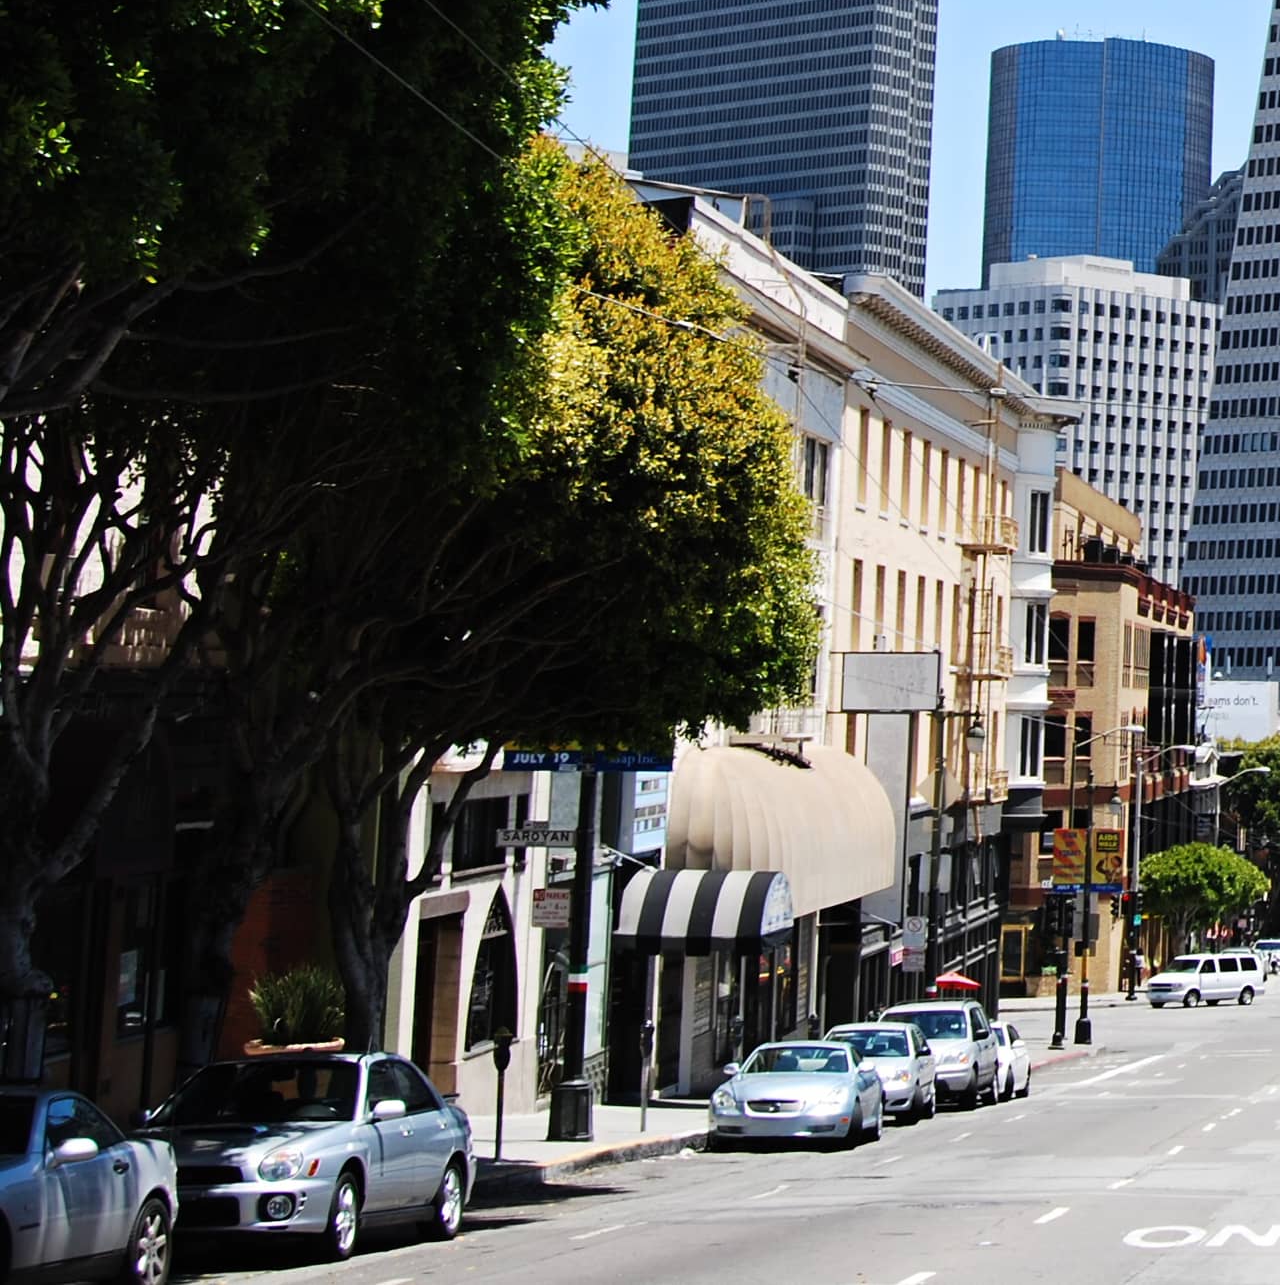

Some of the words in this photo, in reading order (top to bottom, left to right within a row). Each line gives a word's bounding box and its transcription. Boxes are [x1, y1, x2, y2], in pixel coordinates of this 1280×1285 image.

[512, 753, 545, 764] JULY
[554, 752, 571, 763] 19
[502, 831, 570, 843] SAROYAN
